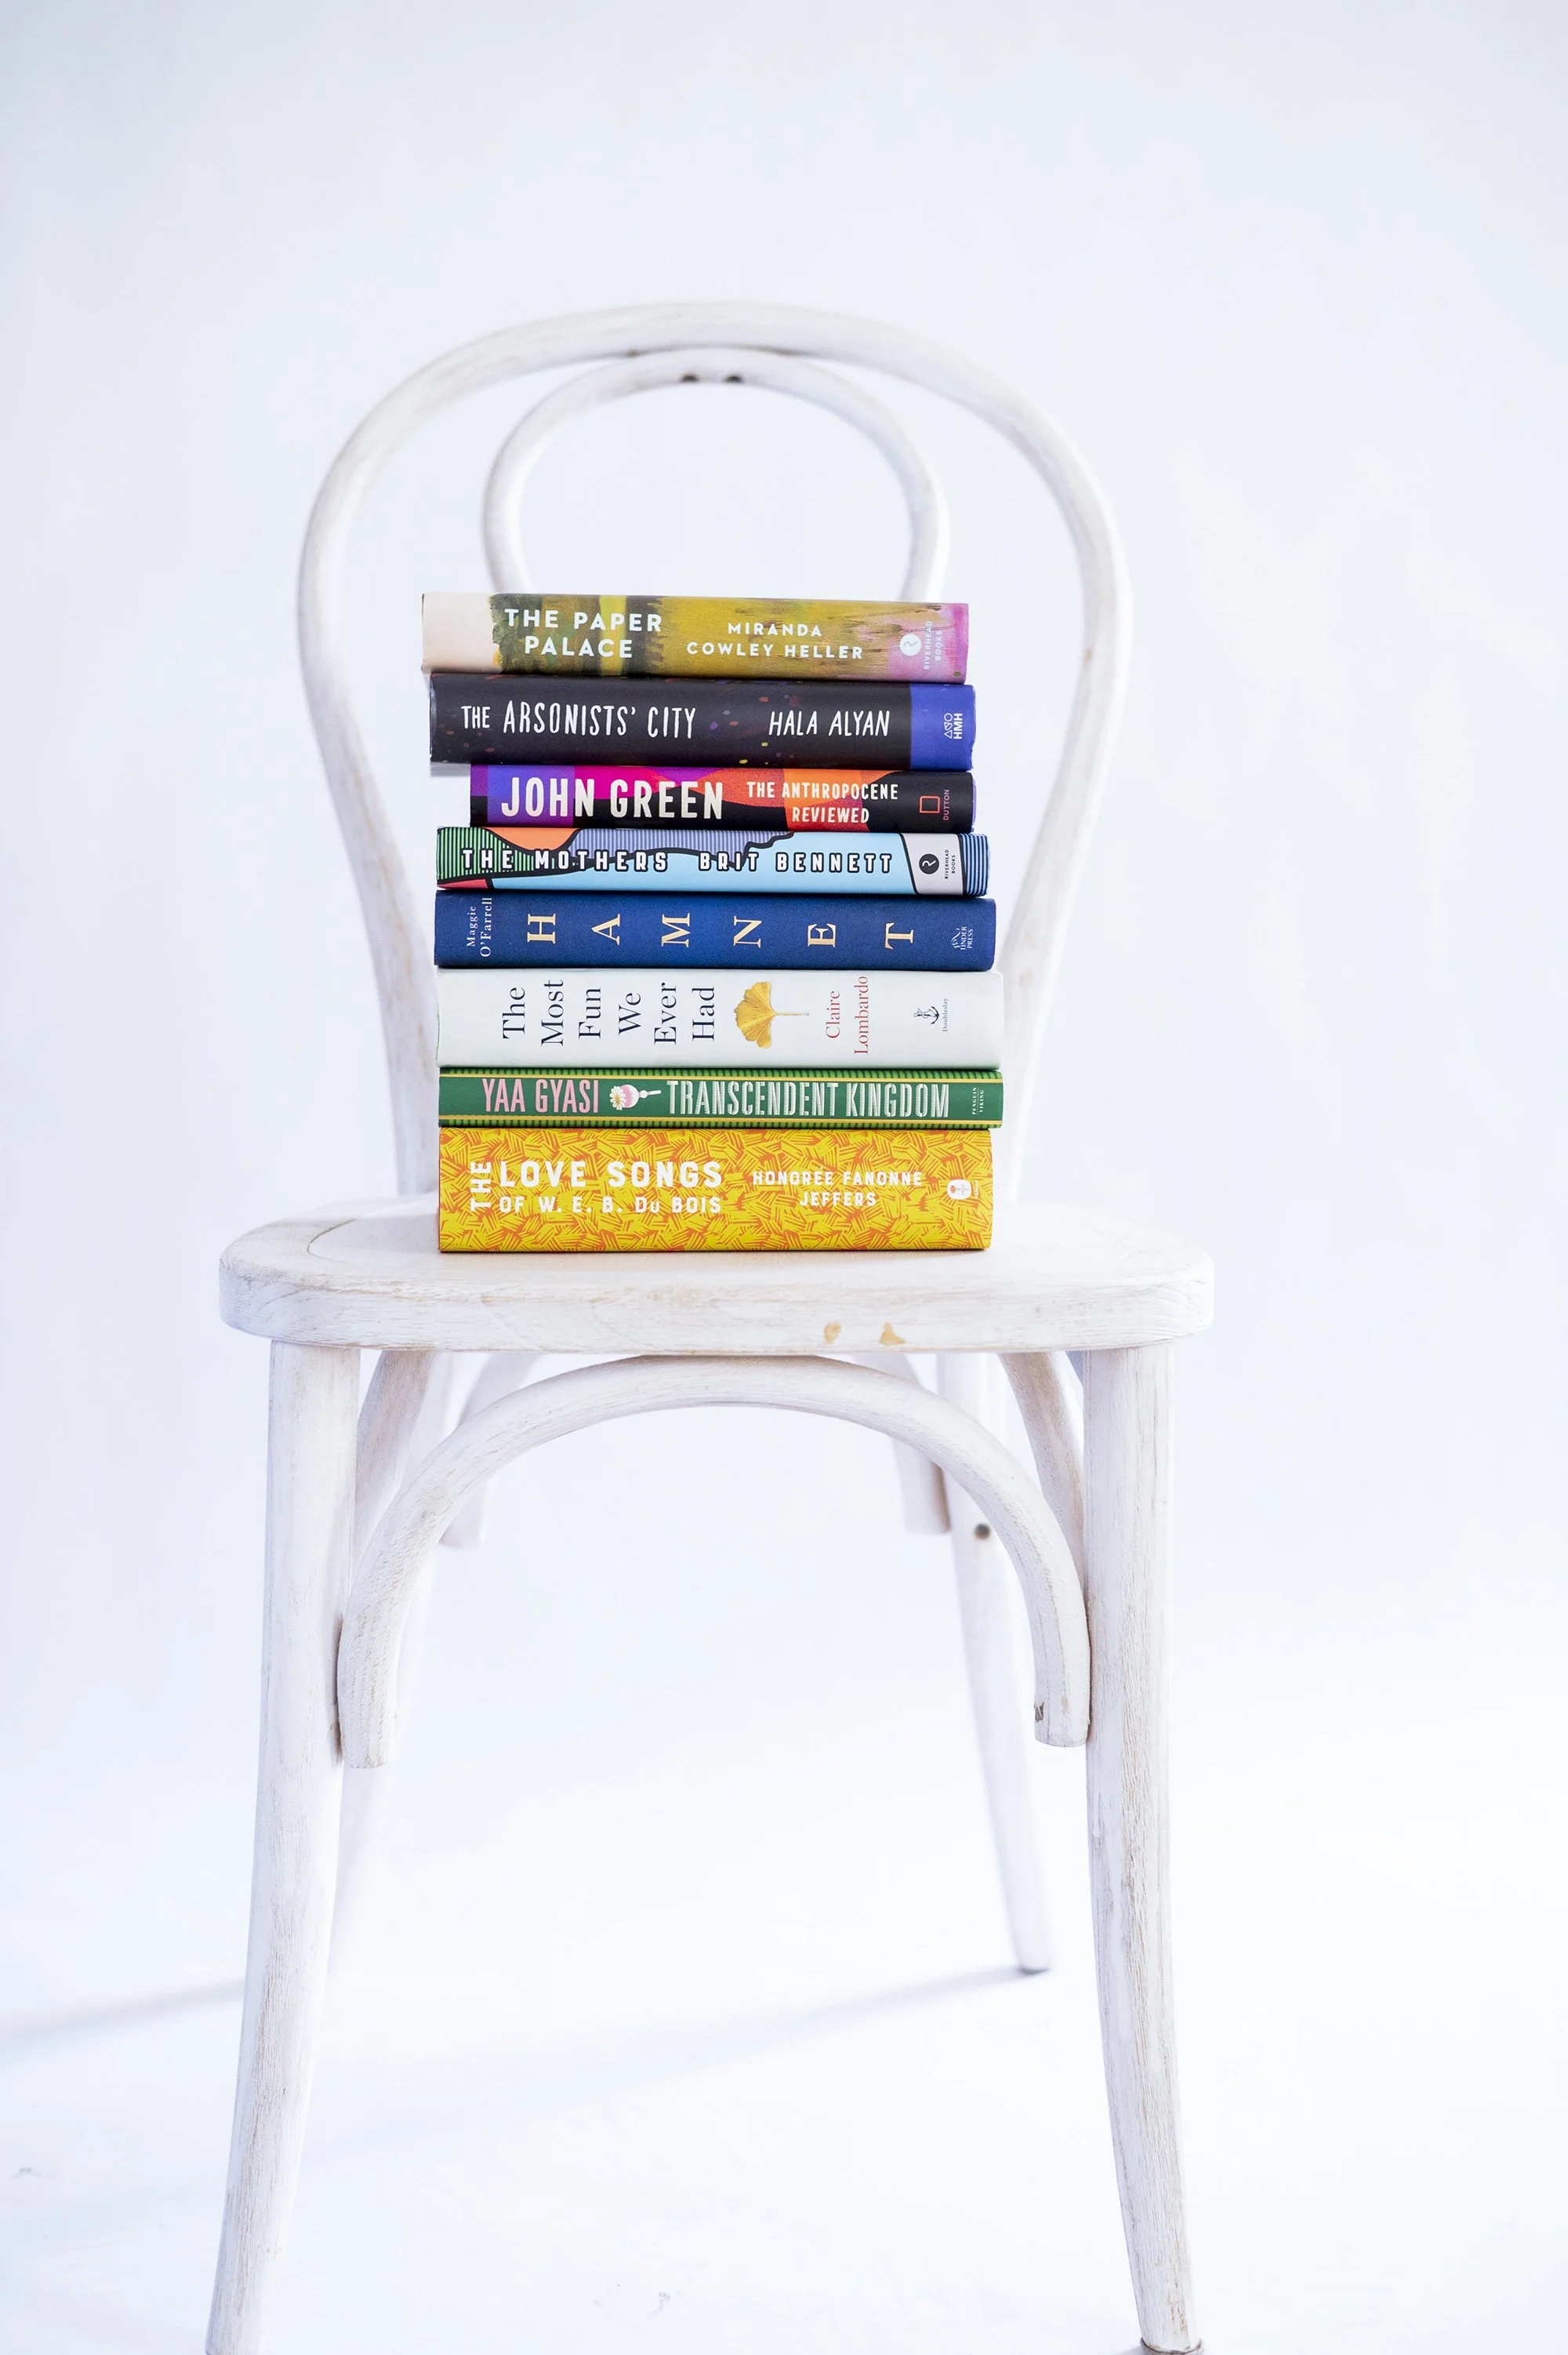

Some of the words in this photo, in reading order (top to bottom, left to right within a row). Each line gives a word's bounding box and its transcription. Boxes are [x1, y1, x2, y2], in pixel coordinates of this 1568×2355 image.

[504, 609, 559, 628] THE
[574, 612, 662, 632] PAPER
[728, 622, 822, 638] MIRANDA
[524, 635, 633, 659] PALACE
[687, 641, 774, 657] COWLEY
[784, 644, 862, 660] HELLER
[923, 620, 933, 670] RIVERHEAD
[461, 706, 491, 729] THE
[503, 700, 637, 736] ARSONISTS’
[647, 706, 696, 740] CITY
[768, 710, 818, 736] HALA
[828, 710, 891, 737] ALYAN
[953, 713, 963, 740] HMH
[501, 776, 596, 817] JOHN
[610, 779, 723, 820] GREEN
[747, 781, 775, 798] THE
[782, 782, 898, 800] ANTHROPOCENE
[792, 807, 869, 823] REVIEWED
[463, 849, 513, 869] THE
[535, 850, 667, 870] MOTHERS
[699, 852, 759, 871] BRIT
[776, 853, 893, 873] BENNETT
[466, 905, 477, 947] Maggie
[480, 897, 492, 958] O’Farrell
[502, 987, 525, 1039] The
[541, 979, 564, 1046] Most
[579, 987, 601, 1039] Fun
[619, 992, 641, 1035] We
[654, 982, 677, 1045] Ever
[692, 986, 715, 1041] Had
[826, 990, 840, 1039] Claire
[854, 976, 869, 1054] Lombardo
[482, 1078, 525, 1112] YAA
[535, 1079, 598, 1113] GYASI
[666, 1080, 839, 1116] TRANSCENDENT
[846, 1083, 949, 1118] KINGDOM
[471, 1161, 491, 1212] THE
[500, 1161, 586, 1188] LOVE
[607, 1161, 722, 1188] SONGS
[753, 1167, 833, 1186] HONORÉE
[843, 1171, 922, 1187] FANONNE
[499, 1196, 525, 1213] OF
[539, 1196, 561, 1213] W.
[572, 1196, 591, 1213] E.
[602, 1196, 622, 1213] B.
[635, 1196, 660, 1213] Du
[672, 1196, 721, 1213] BOIS
[800, 1192, 877, 1207] JEFFERS
